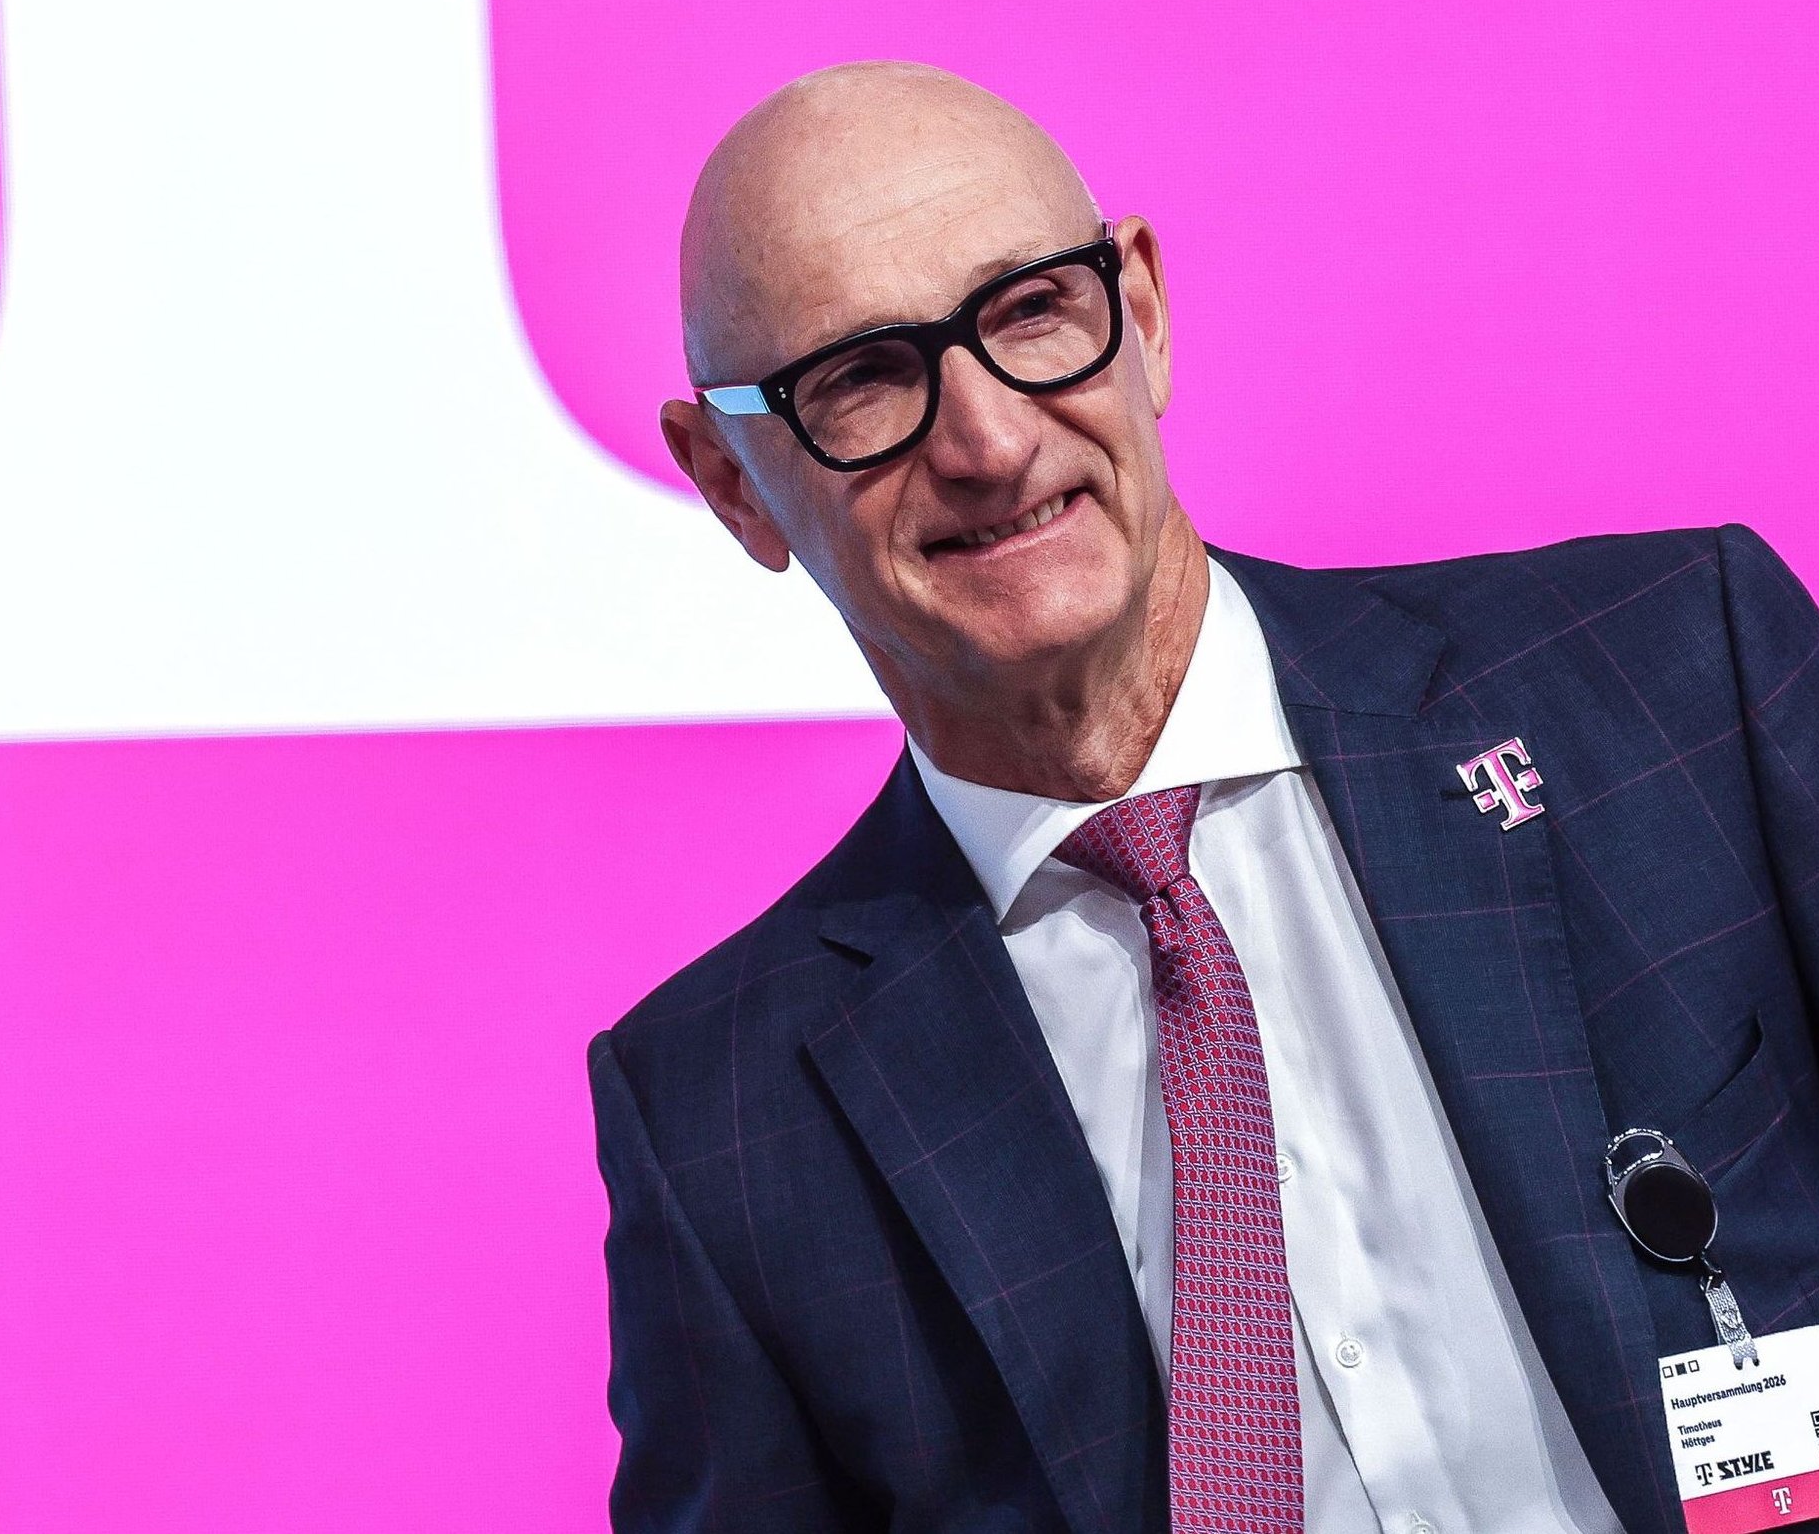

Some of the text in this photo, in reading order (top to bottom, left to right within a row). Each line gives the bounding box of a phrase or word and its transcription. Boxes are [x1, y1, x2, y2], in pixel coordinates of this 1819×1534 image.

[1456, 737, 1545, 831] T
[1671, 1375, 1786, 1410] Hauptversammlung 2026
[1677, 1419, 1722, 1435] Timotheus
[1681, 1435, 1715, 1449] Höttges
[1716, 1451, 1775, 1480] STYLE
